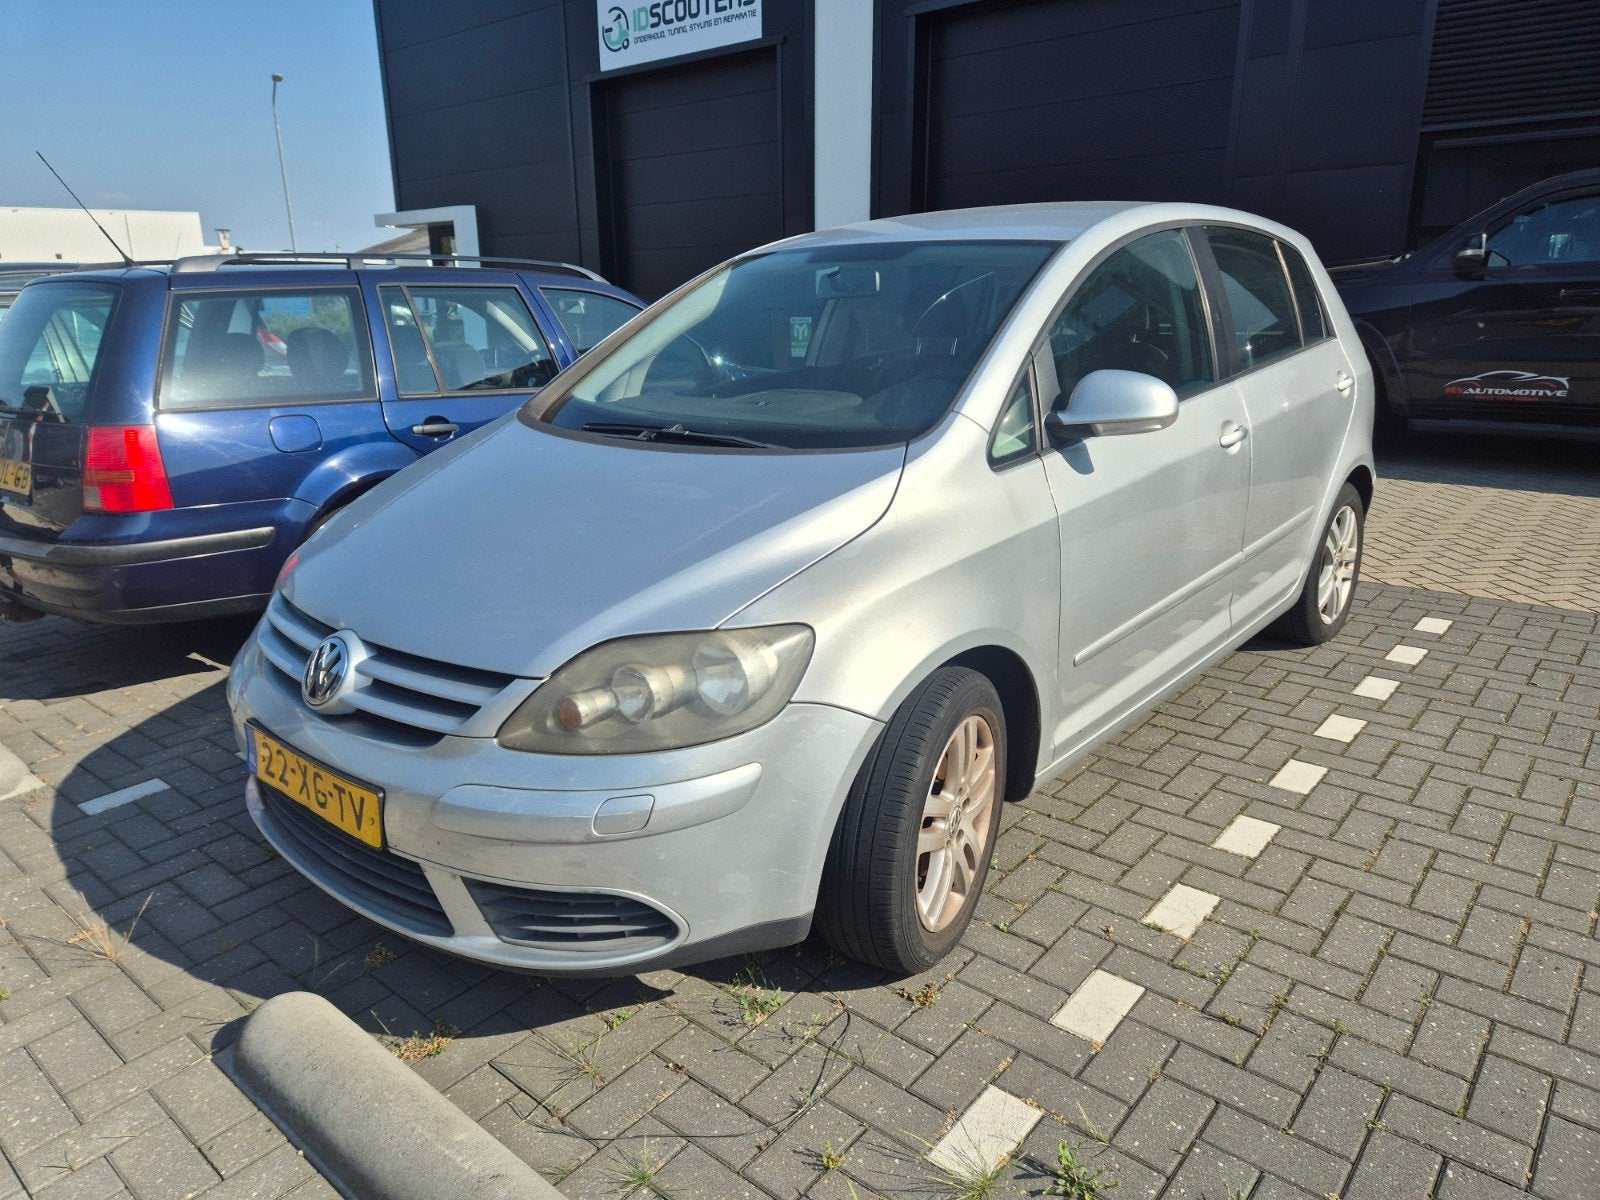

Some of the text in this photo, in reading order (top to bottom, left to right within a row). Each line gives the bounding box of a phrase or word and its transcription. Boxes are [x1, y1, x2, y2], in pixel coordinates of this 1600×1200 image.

[632, 0, 756, 32] IDSCOOTE
[689, 20, 713, 32] STYLING
[714, 17, 722, 26] EN
[723, 9, 757, 24] REPARATIE
[261, 741, 365, 832] 22-XG-TV
